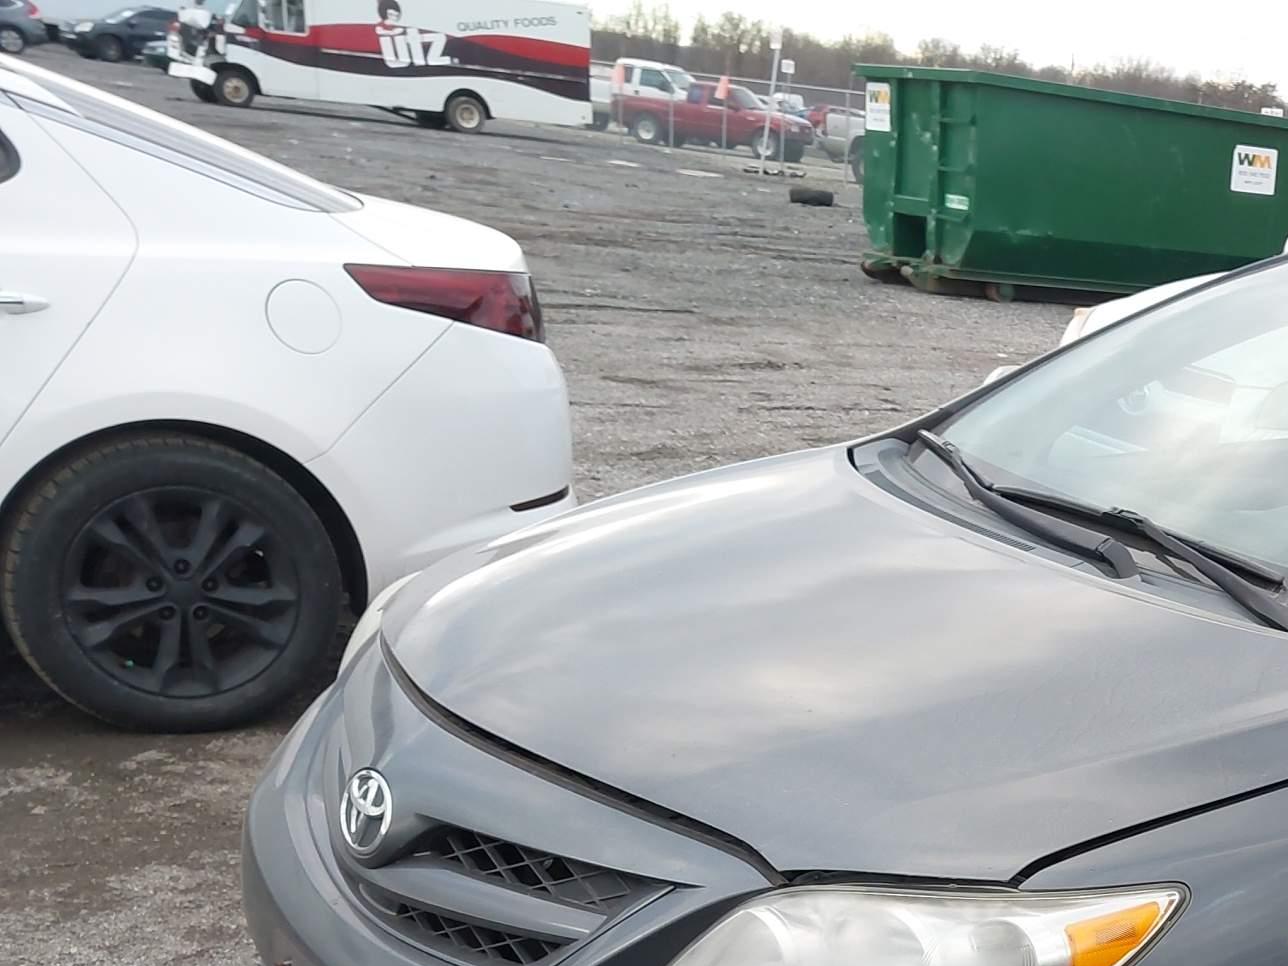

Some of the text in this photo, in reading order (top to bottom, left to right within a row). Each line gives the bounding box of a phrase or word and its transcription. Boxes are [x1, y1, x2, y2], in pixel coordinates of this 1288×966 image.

[456, 16, 557, 32] QUALITY FOODS
[1237, 151, 1273, 169] WM
